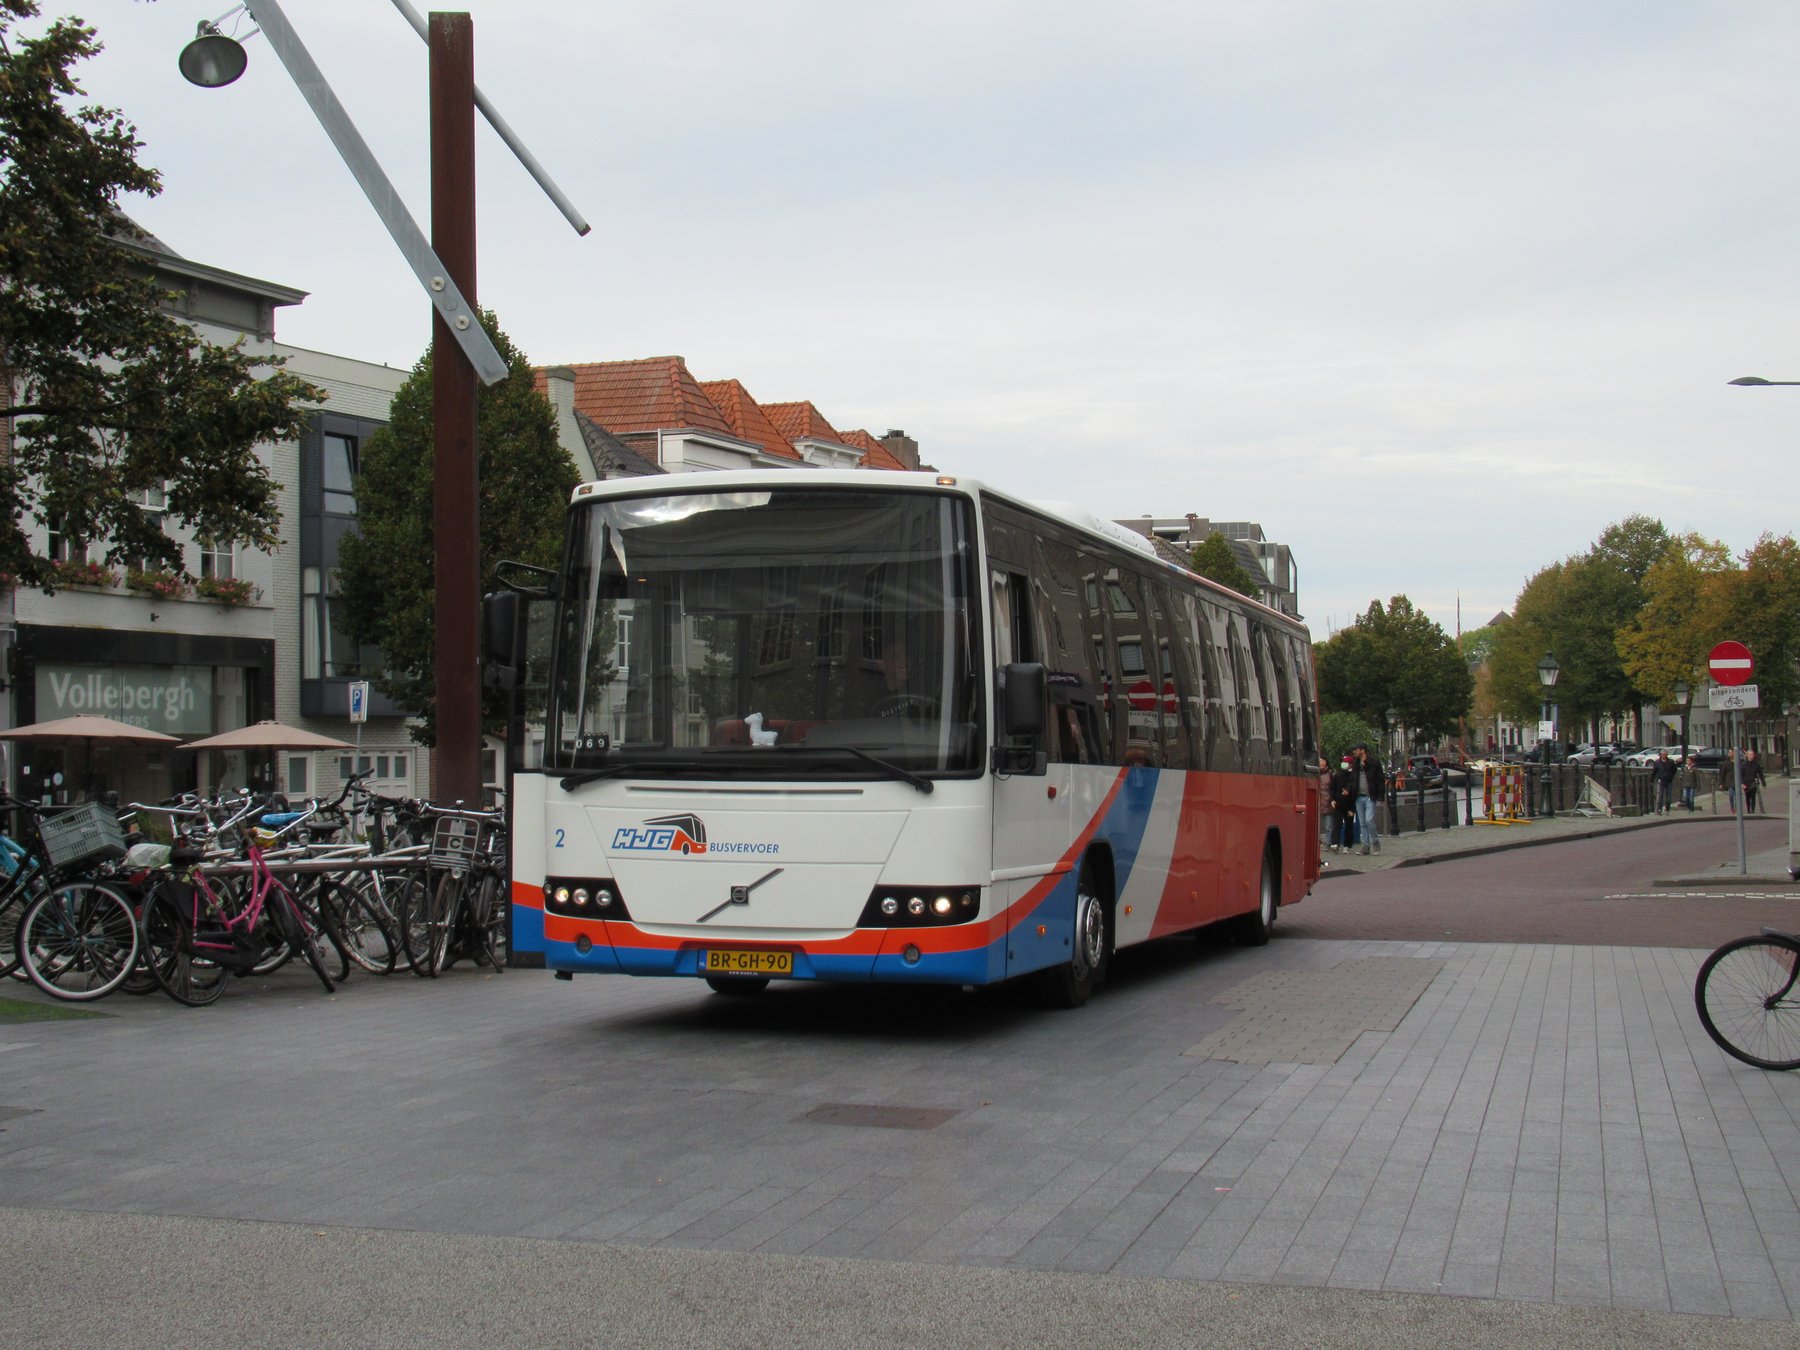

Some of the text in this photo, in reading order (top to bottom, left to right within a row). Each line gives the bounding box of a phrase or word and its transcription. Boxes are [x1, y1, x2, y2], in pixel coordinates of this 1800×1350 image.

[49, 672, 195, 720] Vollebergh
[353, 690, 361, 705] P
[1710, 686, 1756, 696] uitgezonderd
[554, 828, 565, 848] 2
[611, 828, 779, 854] HJG BUSVERVOER
[710, 952, 788, 970] BR-GH-90
